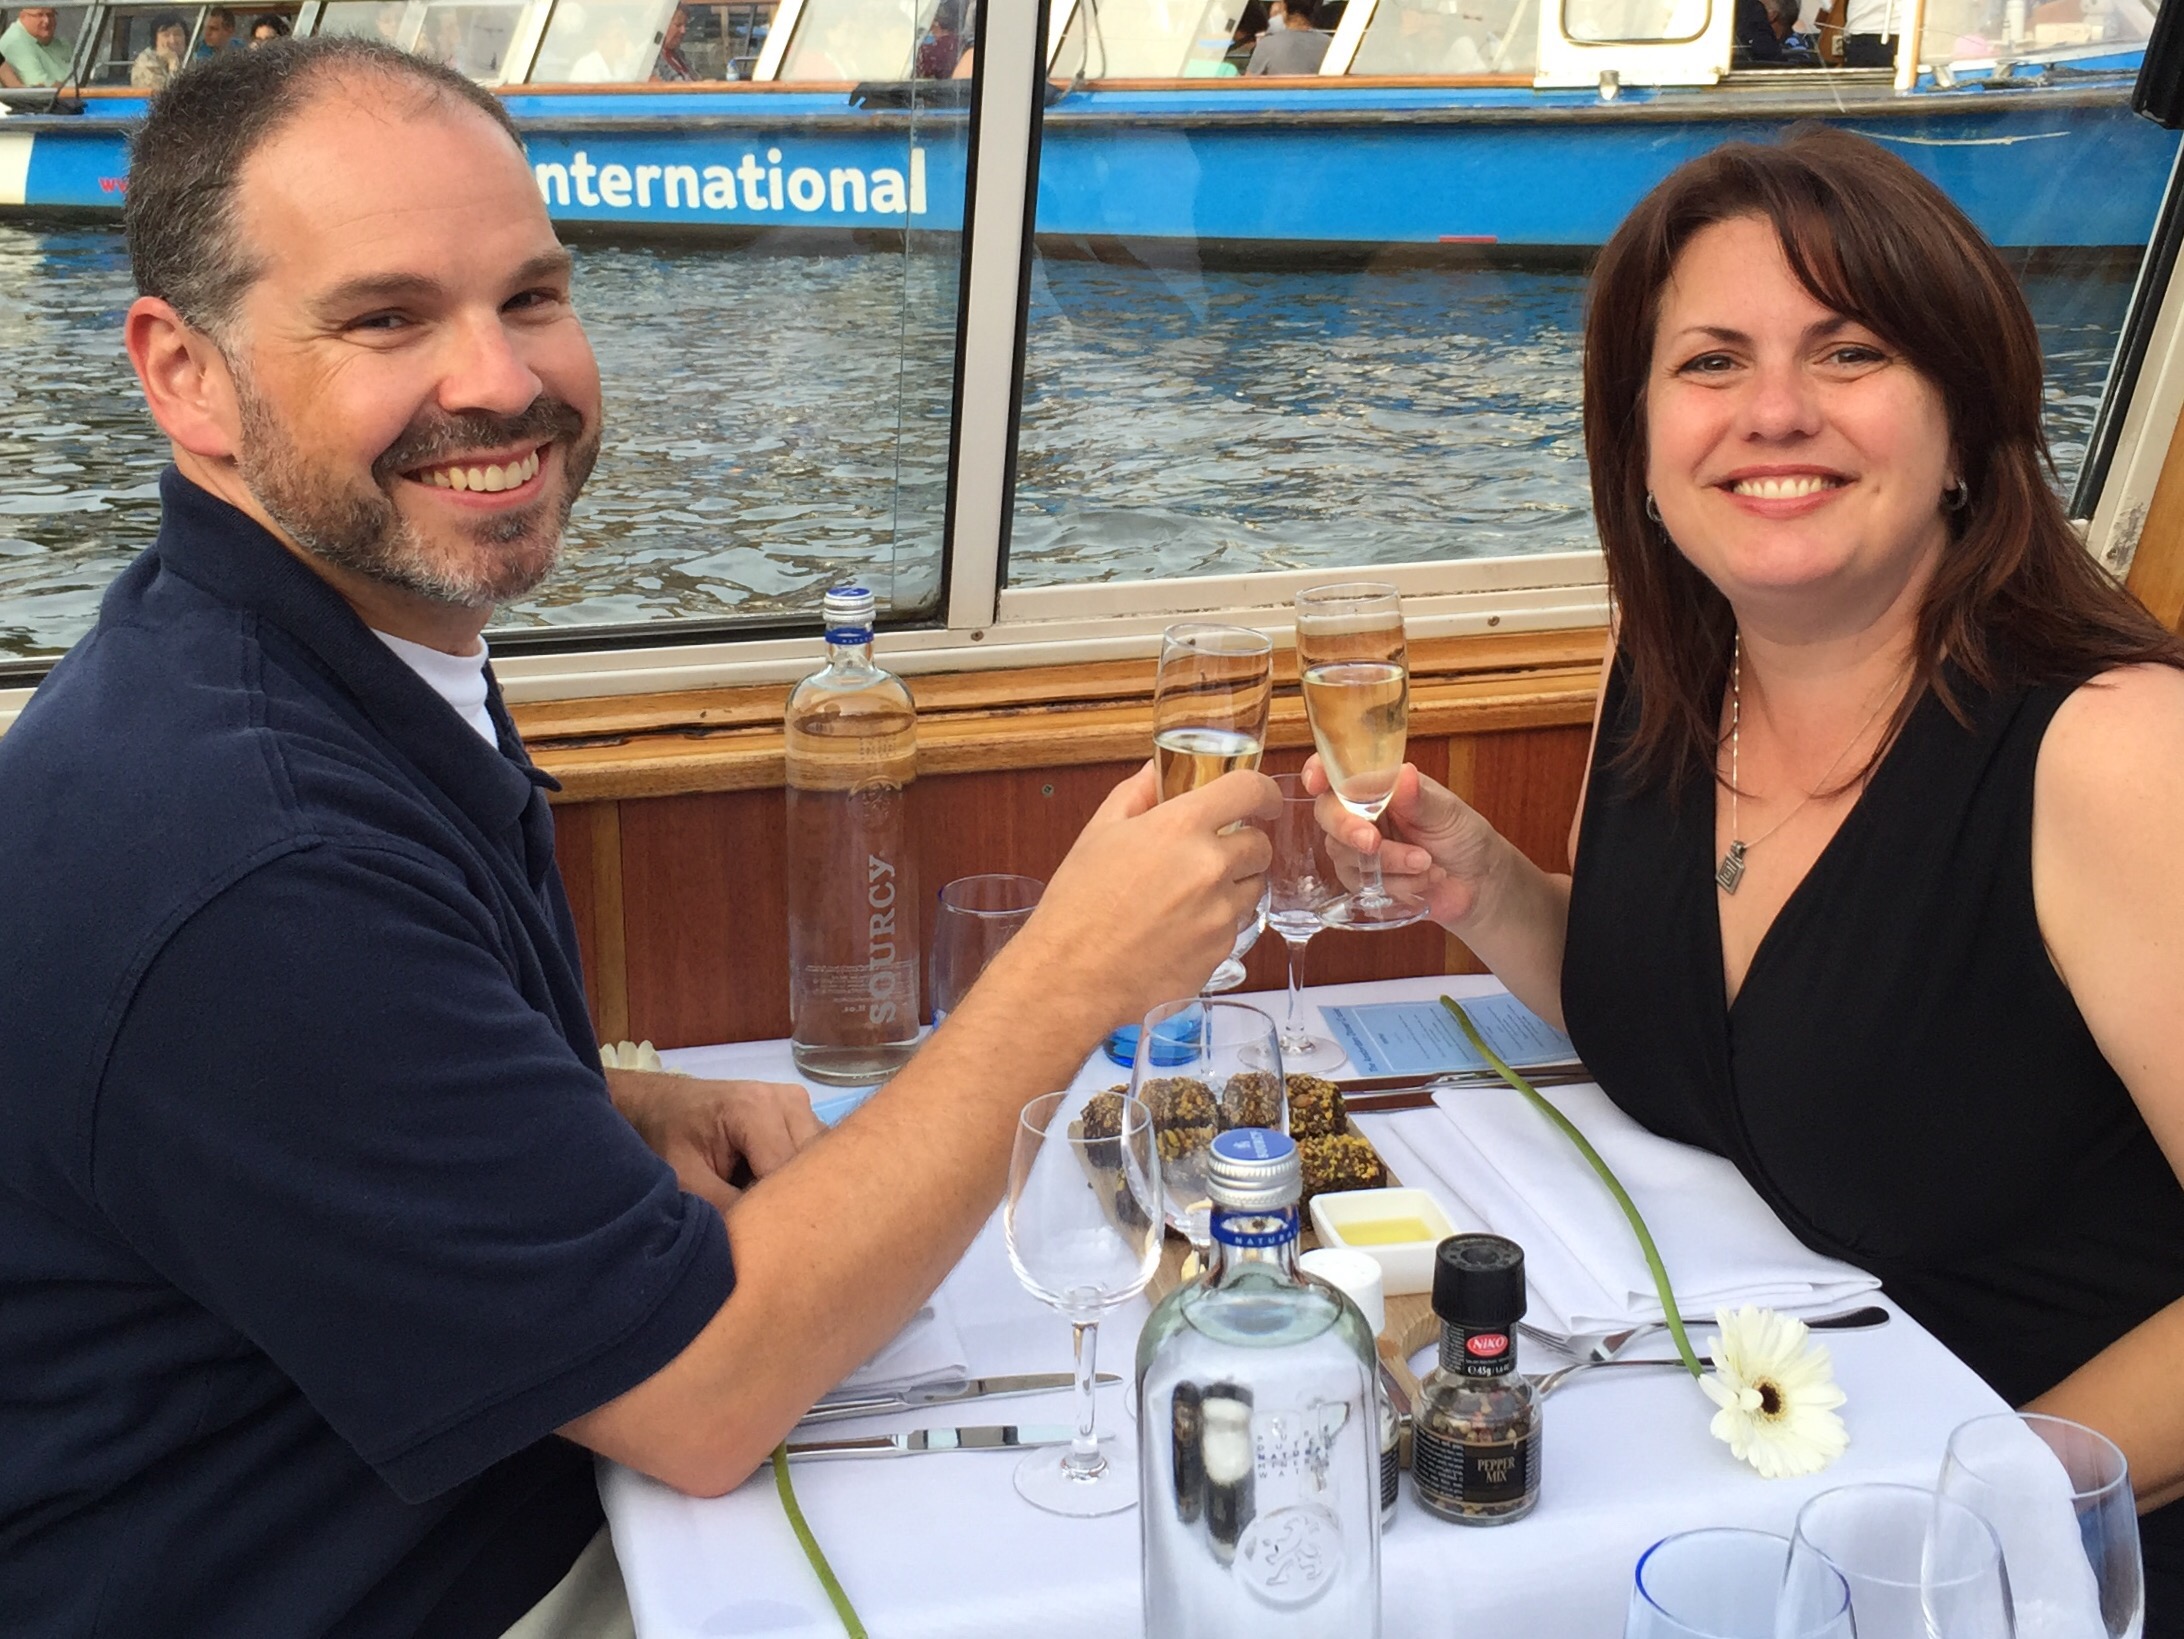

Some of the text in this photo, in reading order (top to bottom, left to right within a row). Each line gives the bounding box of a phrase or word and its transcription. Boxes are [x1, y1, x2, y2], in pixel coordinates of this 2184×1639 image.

[535, 147, 927, 214] nternational
[868, 854, 896, 1024] SOURCY
[1472, 1336, 1505, 1350] NIKO
[1477, 1456, 1515, 1471] PEPPER
[1487, 1470, 1507, 1483] MIX
